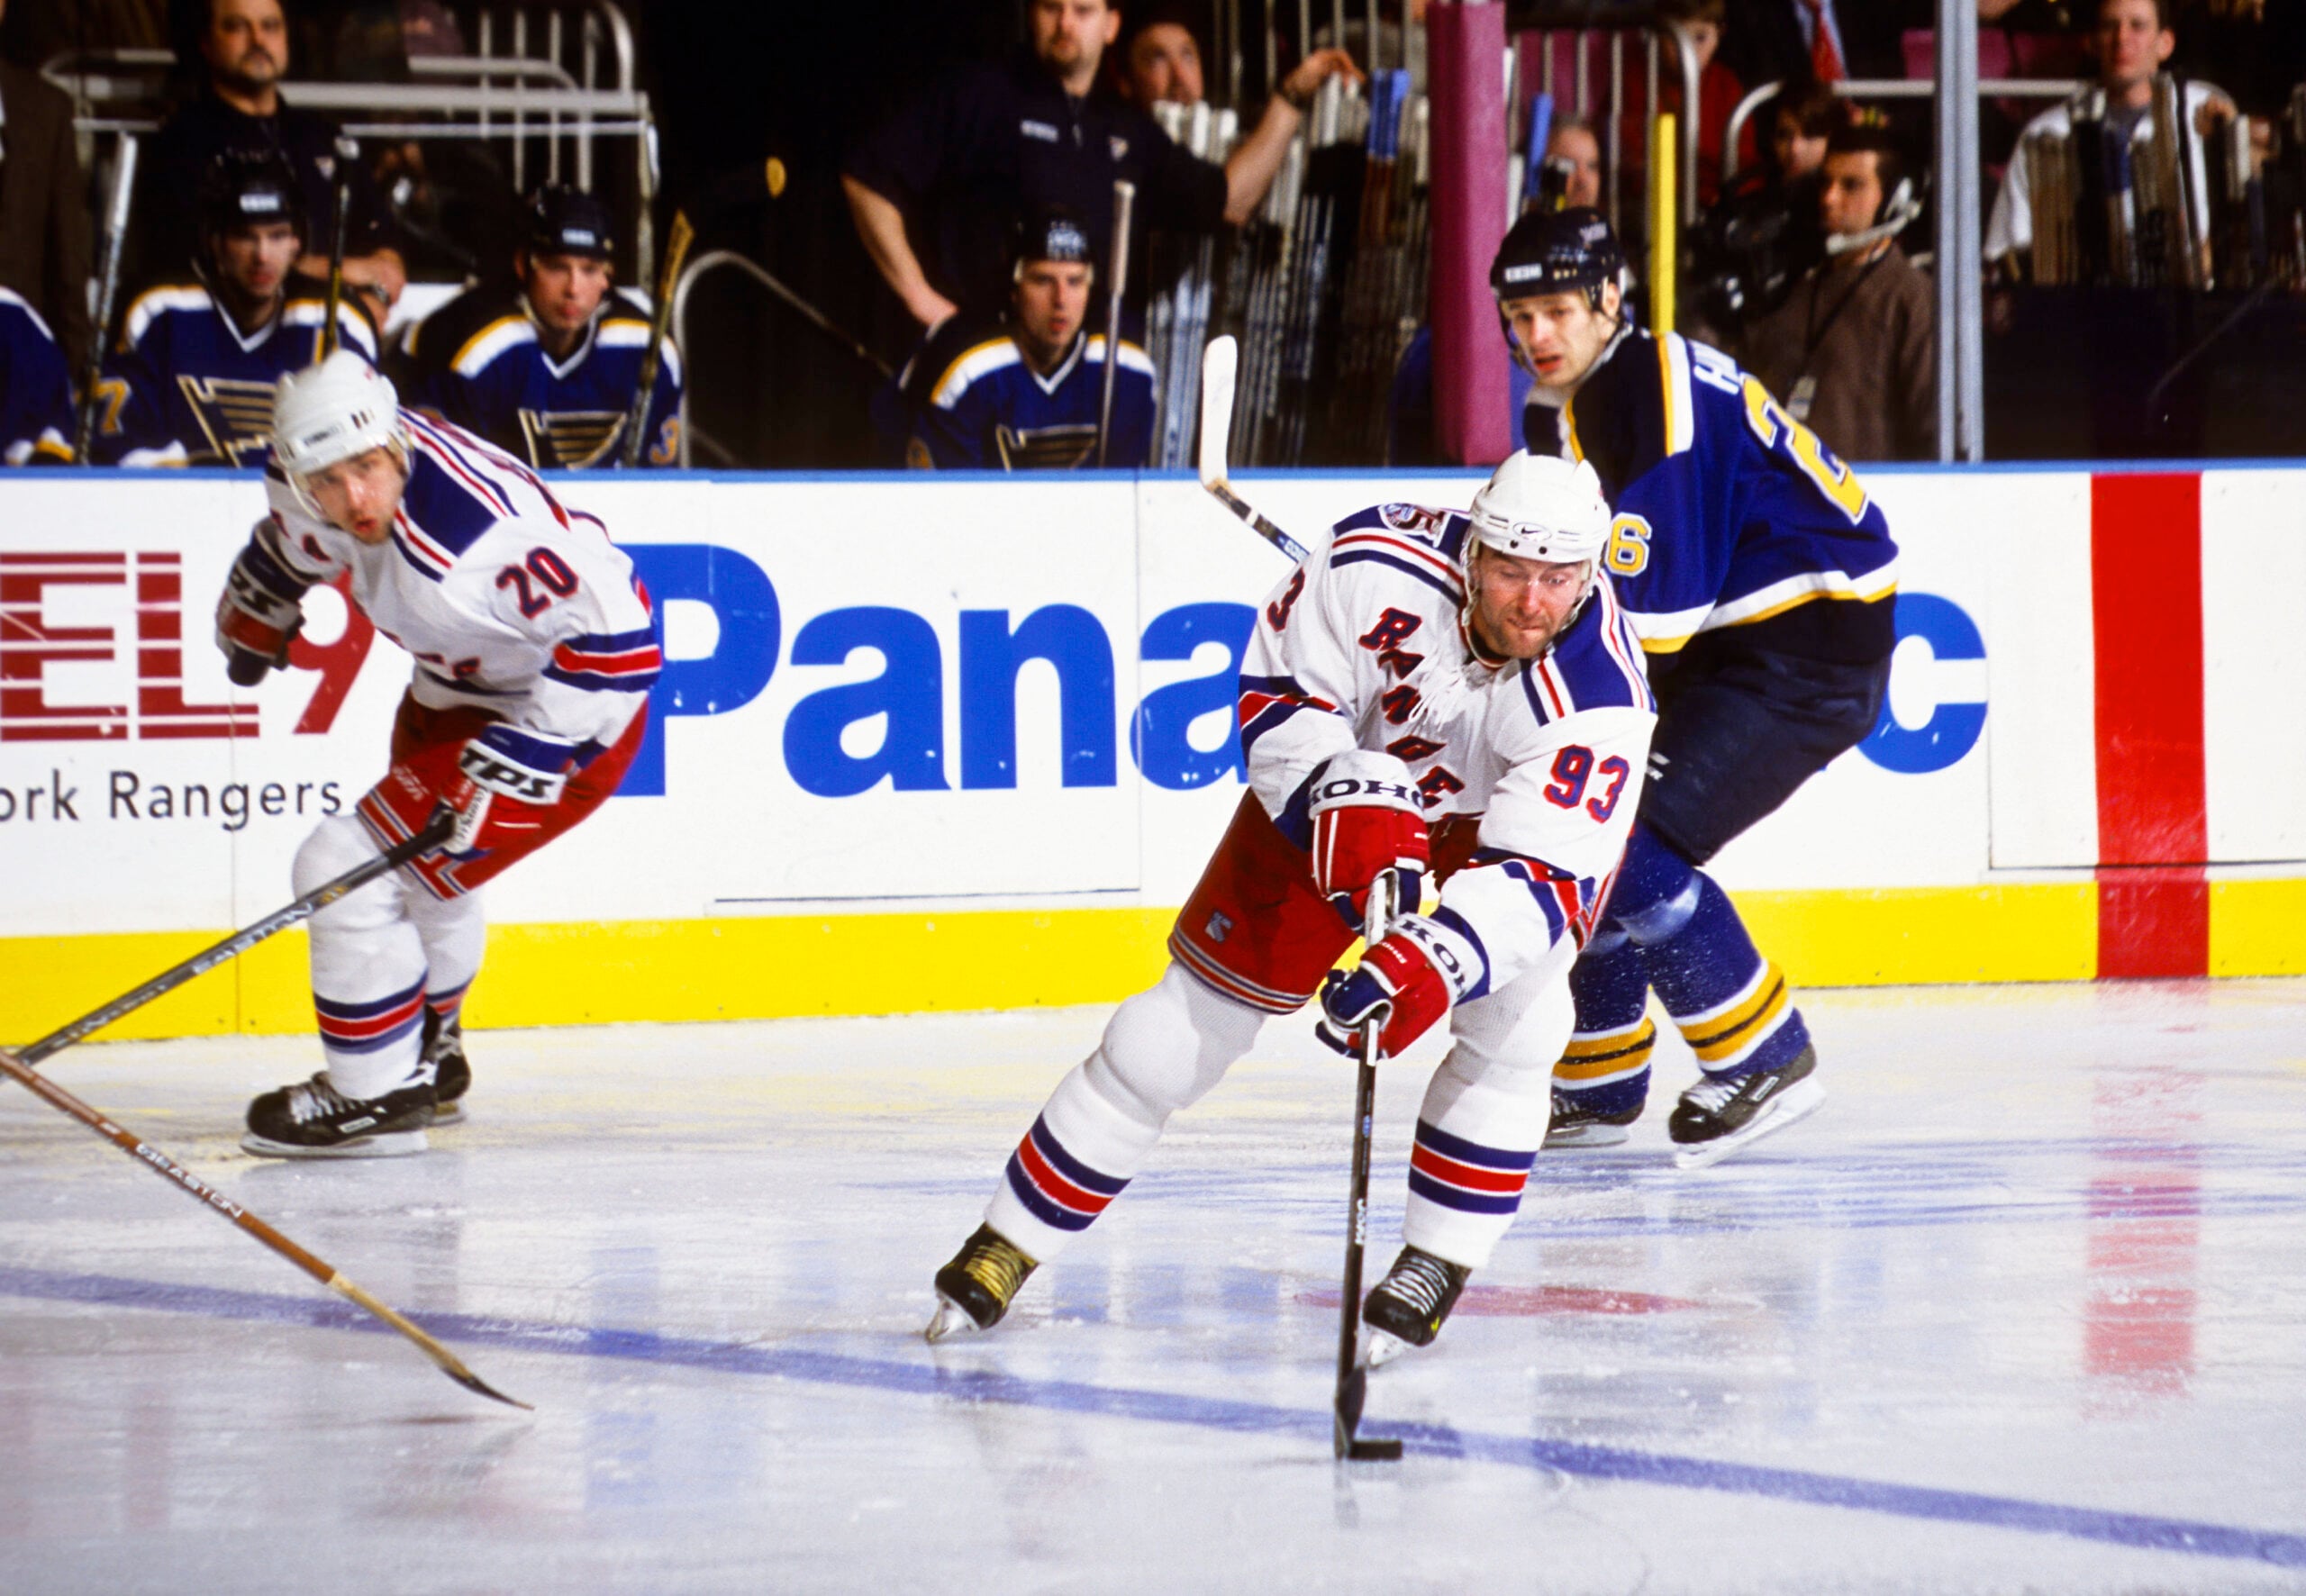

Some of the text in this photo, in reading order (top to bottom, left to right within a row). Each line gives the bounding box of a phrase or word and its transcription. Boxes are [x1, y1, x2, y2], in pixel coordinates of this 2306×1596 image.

[1605, 512, 1653, 577] 6
[495, 546, 578, 621] 20
[1358, 607, 1486, 820] RANGE
[110, 770, 342, 831] Rangers
[459, 746, 555, 798] TPS
[1543, 744, 1630, 823] 93
